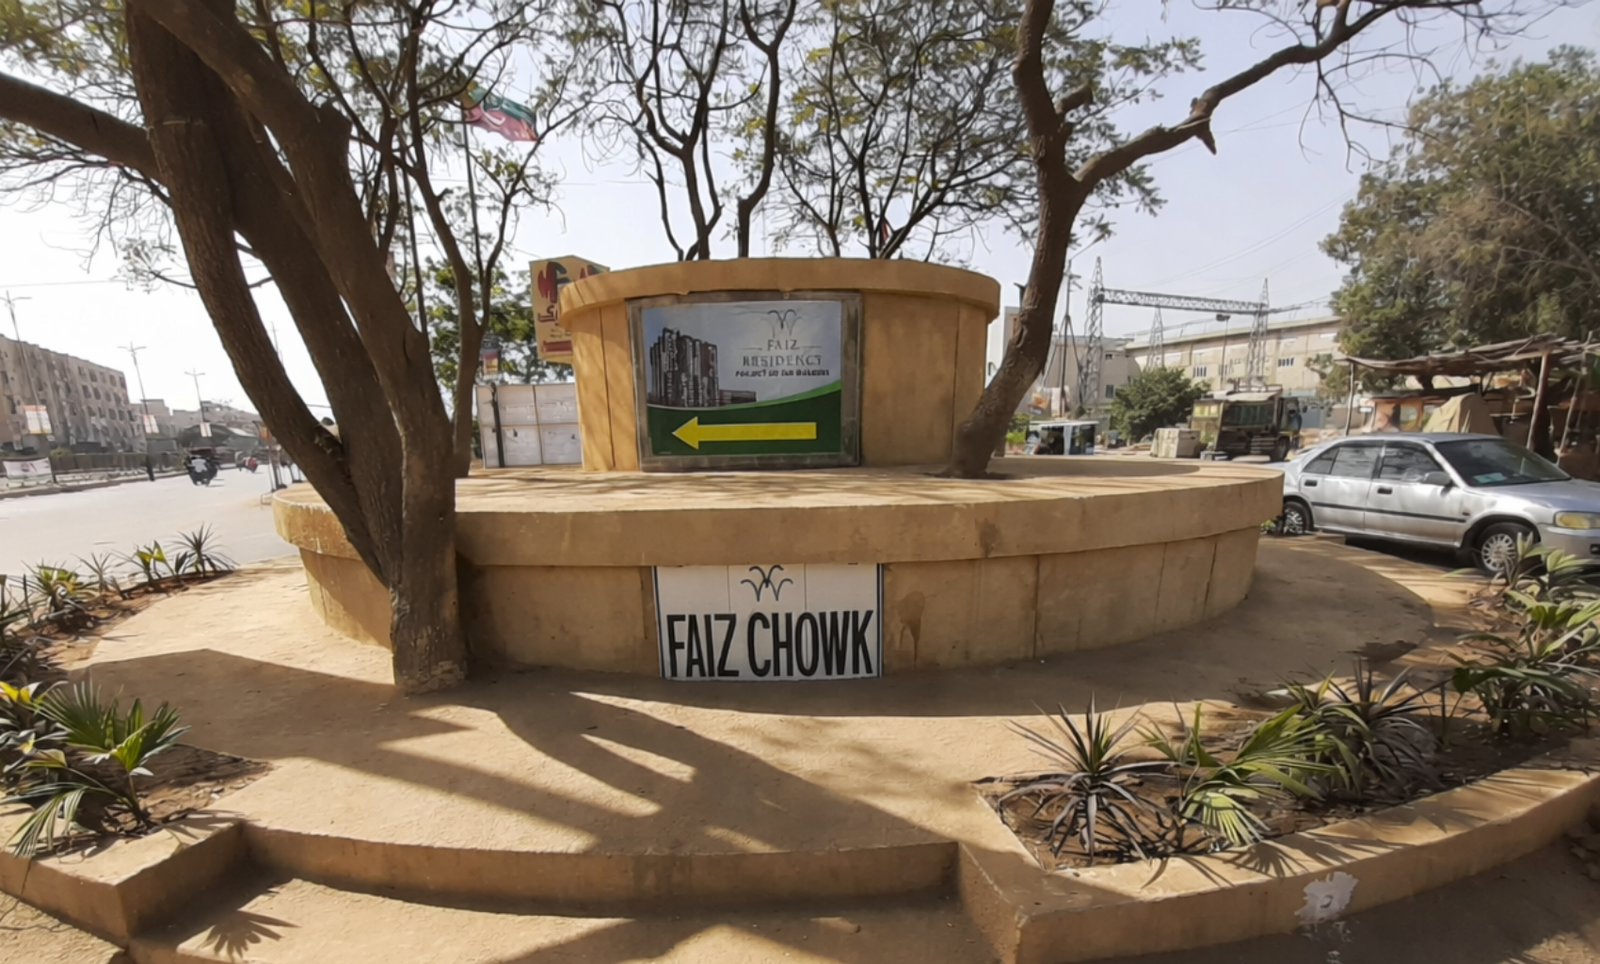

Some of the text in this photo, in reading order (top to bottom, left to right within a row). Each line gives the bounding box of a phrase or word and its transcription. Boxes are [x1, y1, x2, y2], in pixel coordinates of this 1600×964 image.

[767, 339, 800, 351] FAIZ
[666, 610, 874, 677] FAIZ CHOWK
